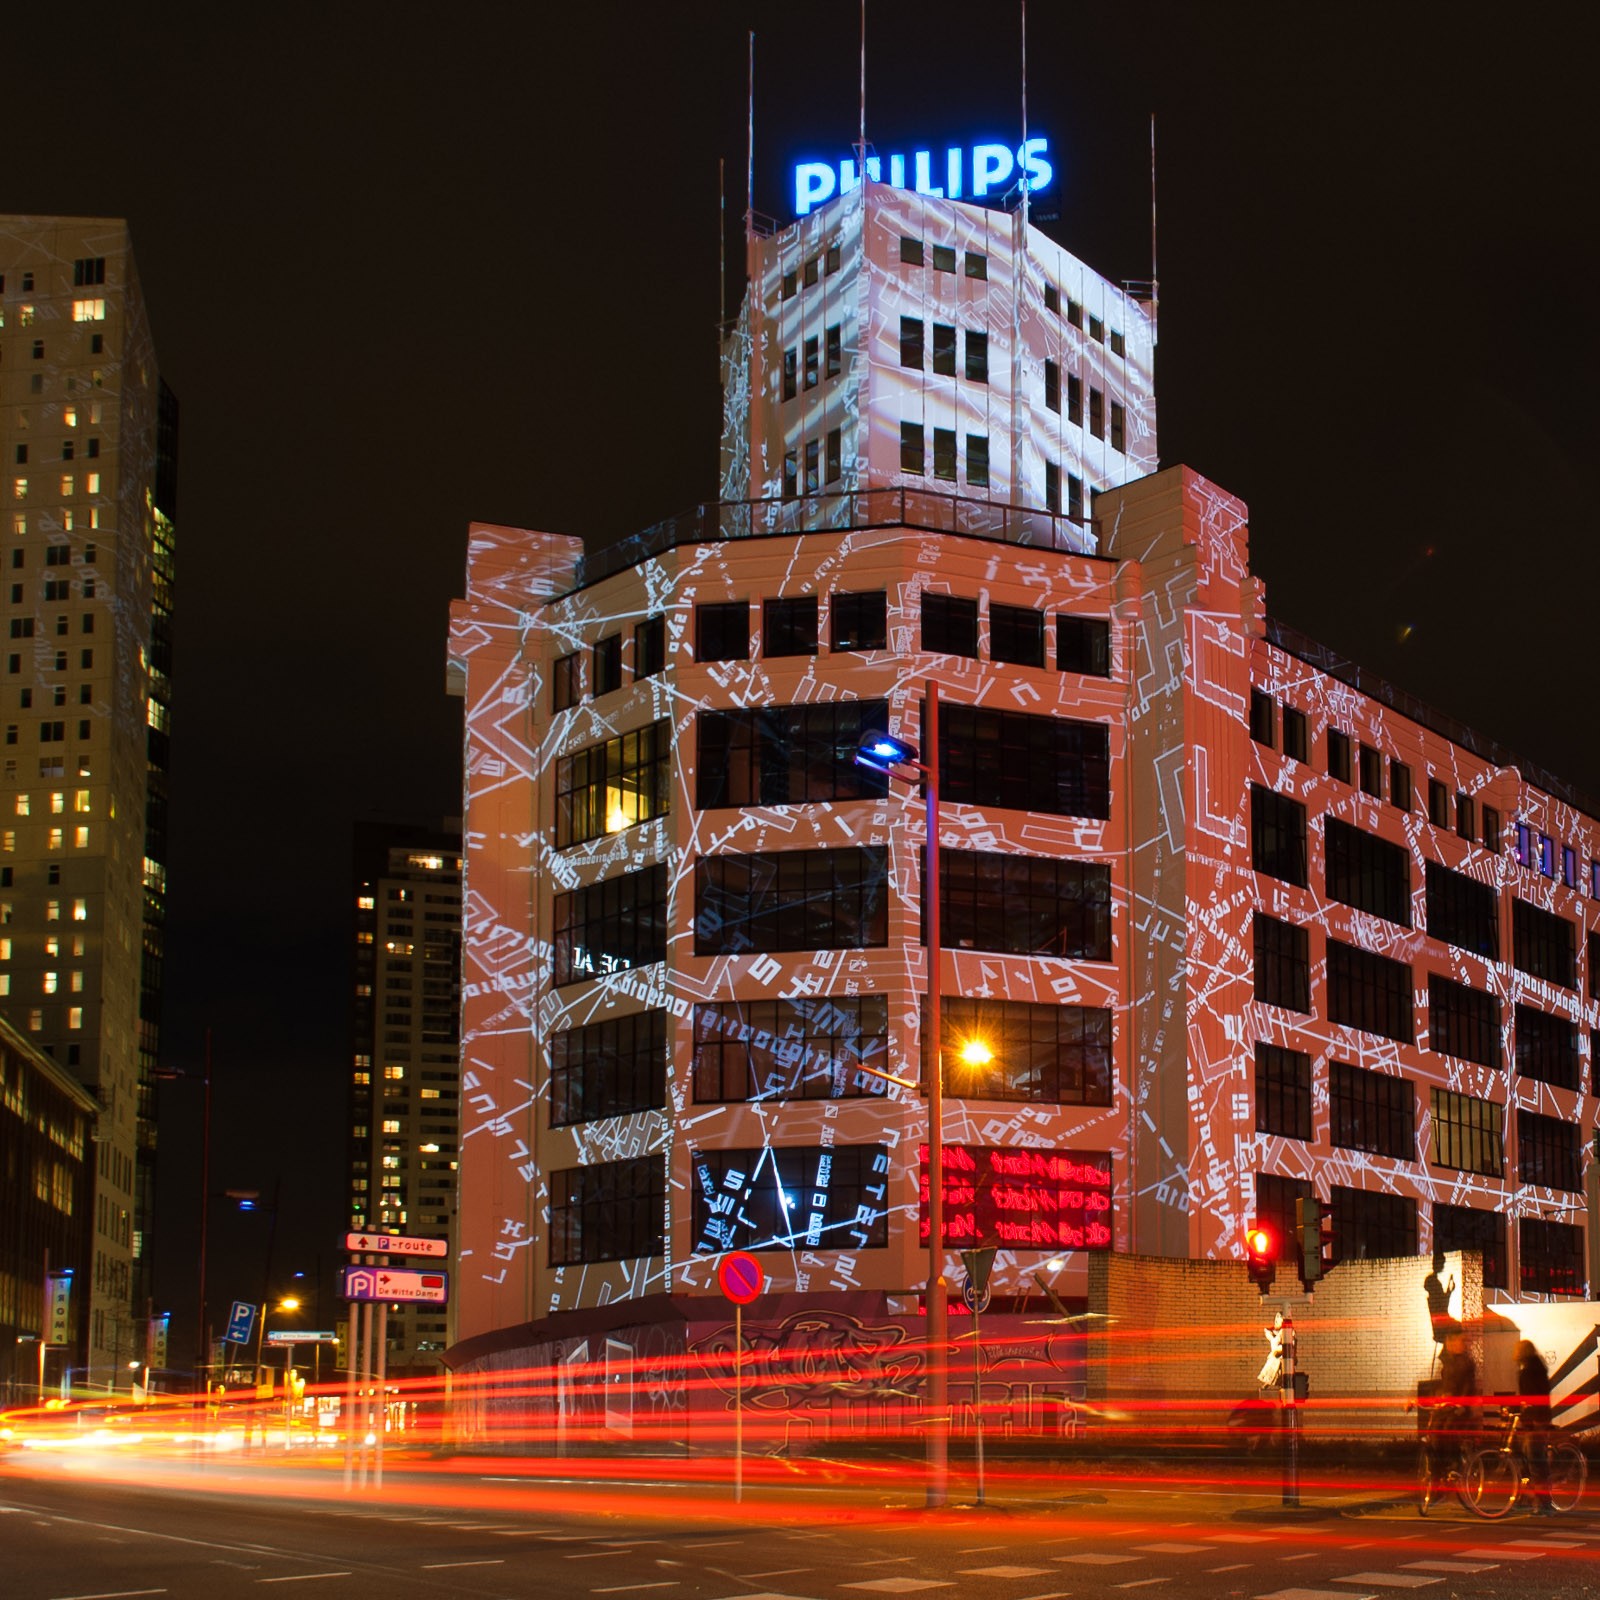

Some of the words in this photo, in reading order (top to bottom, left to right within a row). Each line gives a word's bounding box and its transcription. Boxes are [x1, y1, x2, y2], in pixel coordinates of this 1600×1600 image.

[795, 138, 1053, 215] PHILIPS
[378, 1287, 389, 1295] De
[392, 1288, 414, 1296] Witte
[415, 1289, 439, 1298] Dame
[234, 1304, 250, 1322] P
